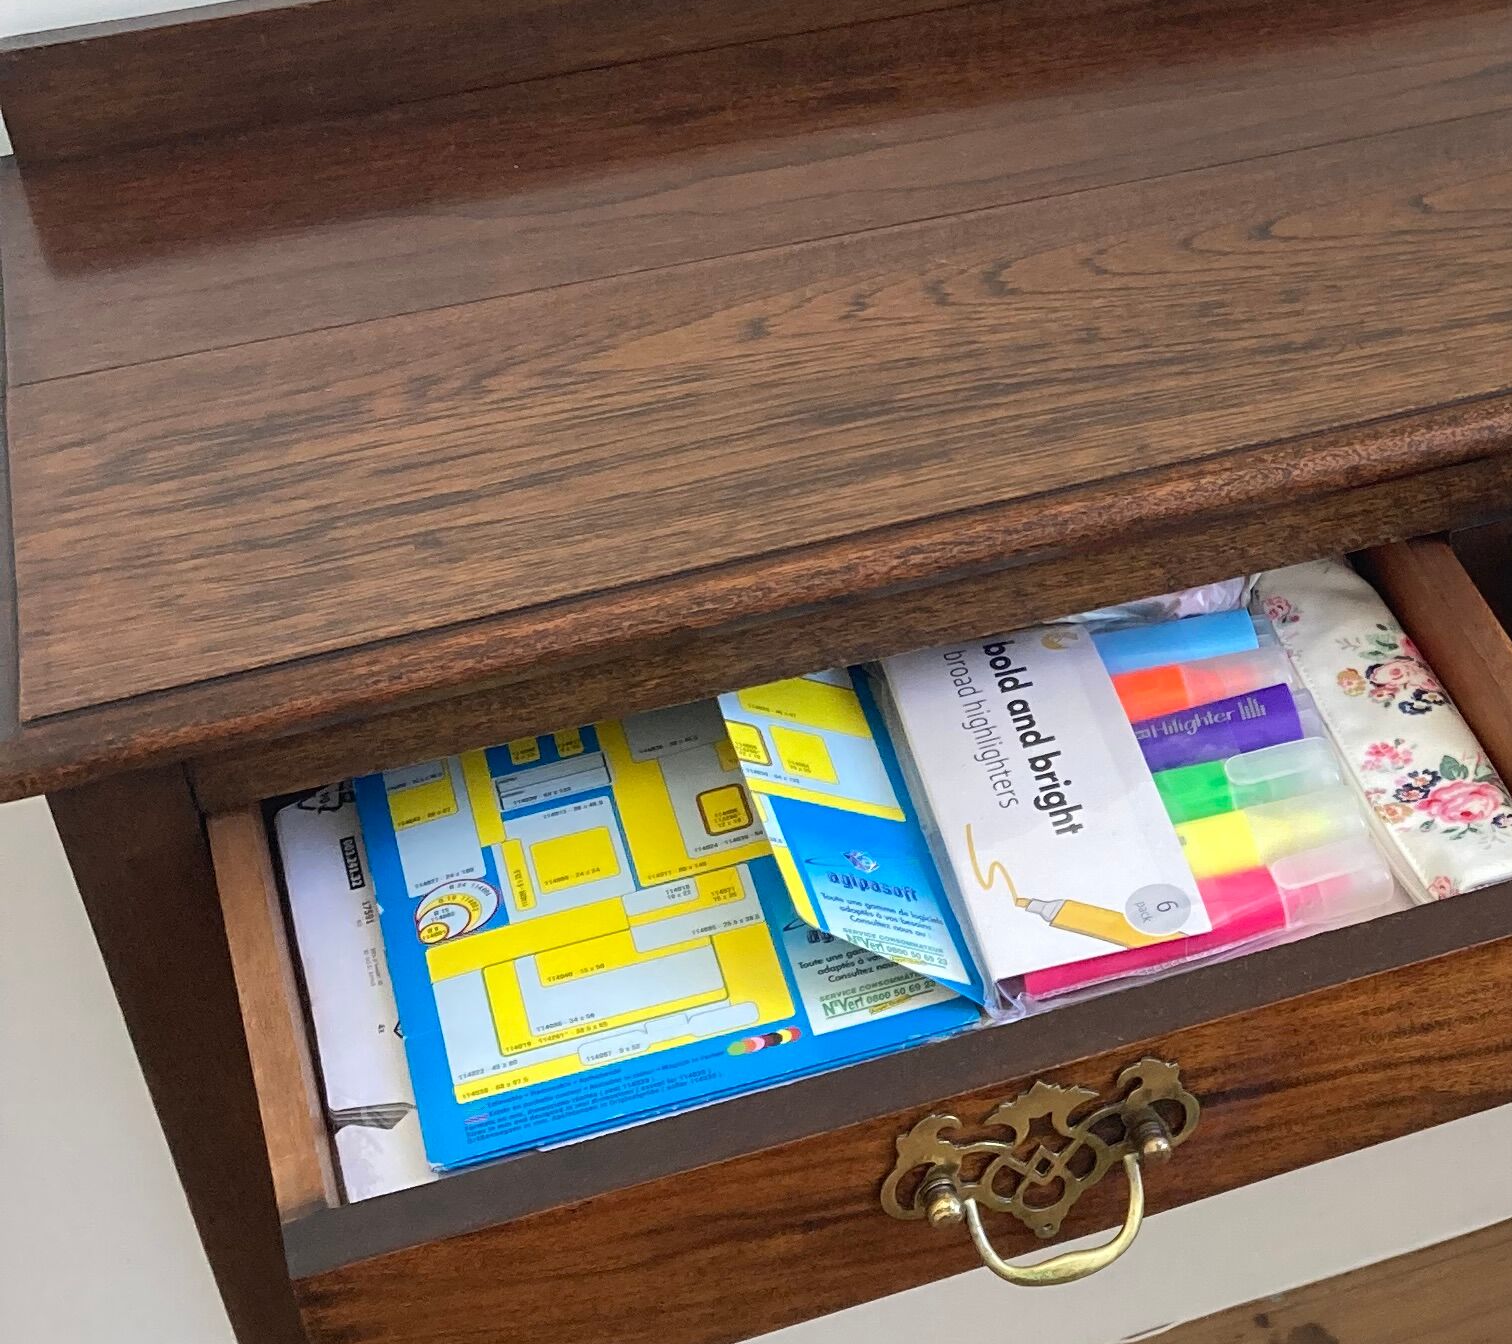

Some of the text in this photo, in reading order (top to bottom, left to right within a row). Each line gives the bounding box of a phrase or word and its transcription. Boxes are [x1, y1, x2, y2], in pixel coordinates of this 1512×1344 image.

[943, 650, 1019, 809] broad highlighters
[983, 640, 1084, 836] bold and bright
[826, 871, 918, 902] agipasoft
[1134, 901, 1153, 924] pack
[1156, 900, 1179, 913] 6
[797, 957, 823, 969] Toute
[826, 952, 845, 963] une
[817, 961, 857, 976] adaptés
[827, 967, 874, 983] Consultez
[819, 986, 857, 1001] SERVICE
[865, 990, 891, 1003] 0800
[893, 987, 907, 998] 50
